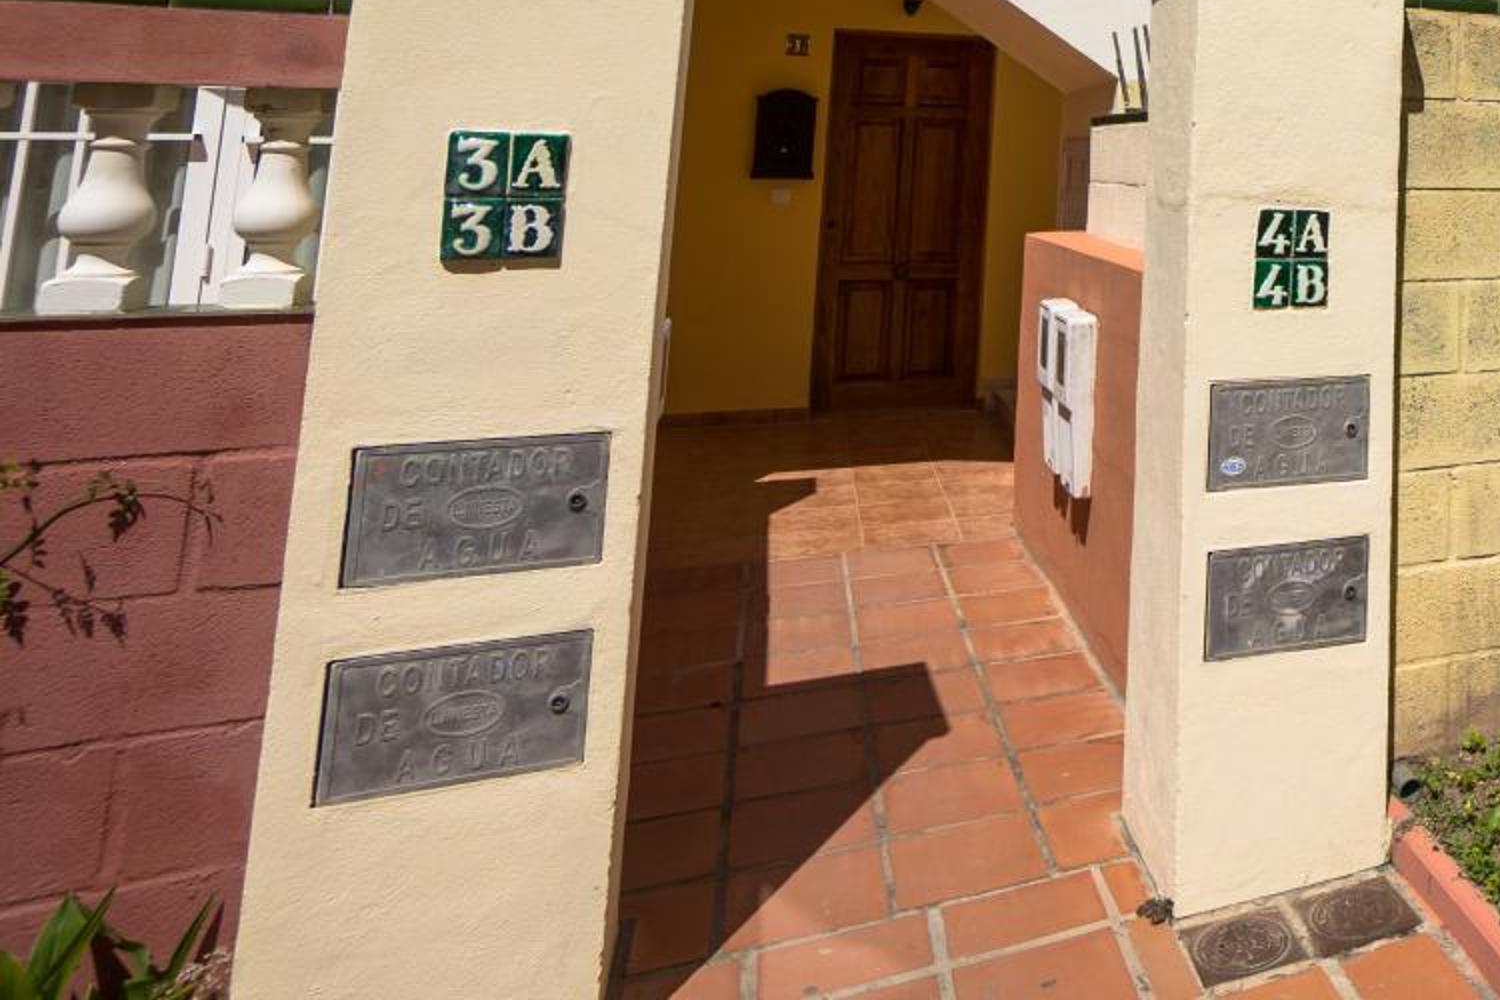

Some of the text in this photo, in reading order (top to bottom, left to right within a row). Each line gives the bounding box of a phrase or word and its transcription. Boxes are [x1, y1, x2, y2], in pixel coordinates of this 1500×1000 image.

[457, 135, 561, 190] 3A
[451, 200, 554, 256] 3B
[1258, 212, 1327, 255] 4A
[1256, 263, 1325, 305] 4B
[399, 446, 576, 488] CONTADOR
[382, 501, 427, 533] DE
[417, 529, 542, 571] AGUA
[376, 648, 555, 698] CONTADOR
[353, 708, 401, 747] DE
[397, 741, 523, 784] AGUA
